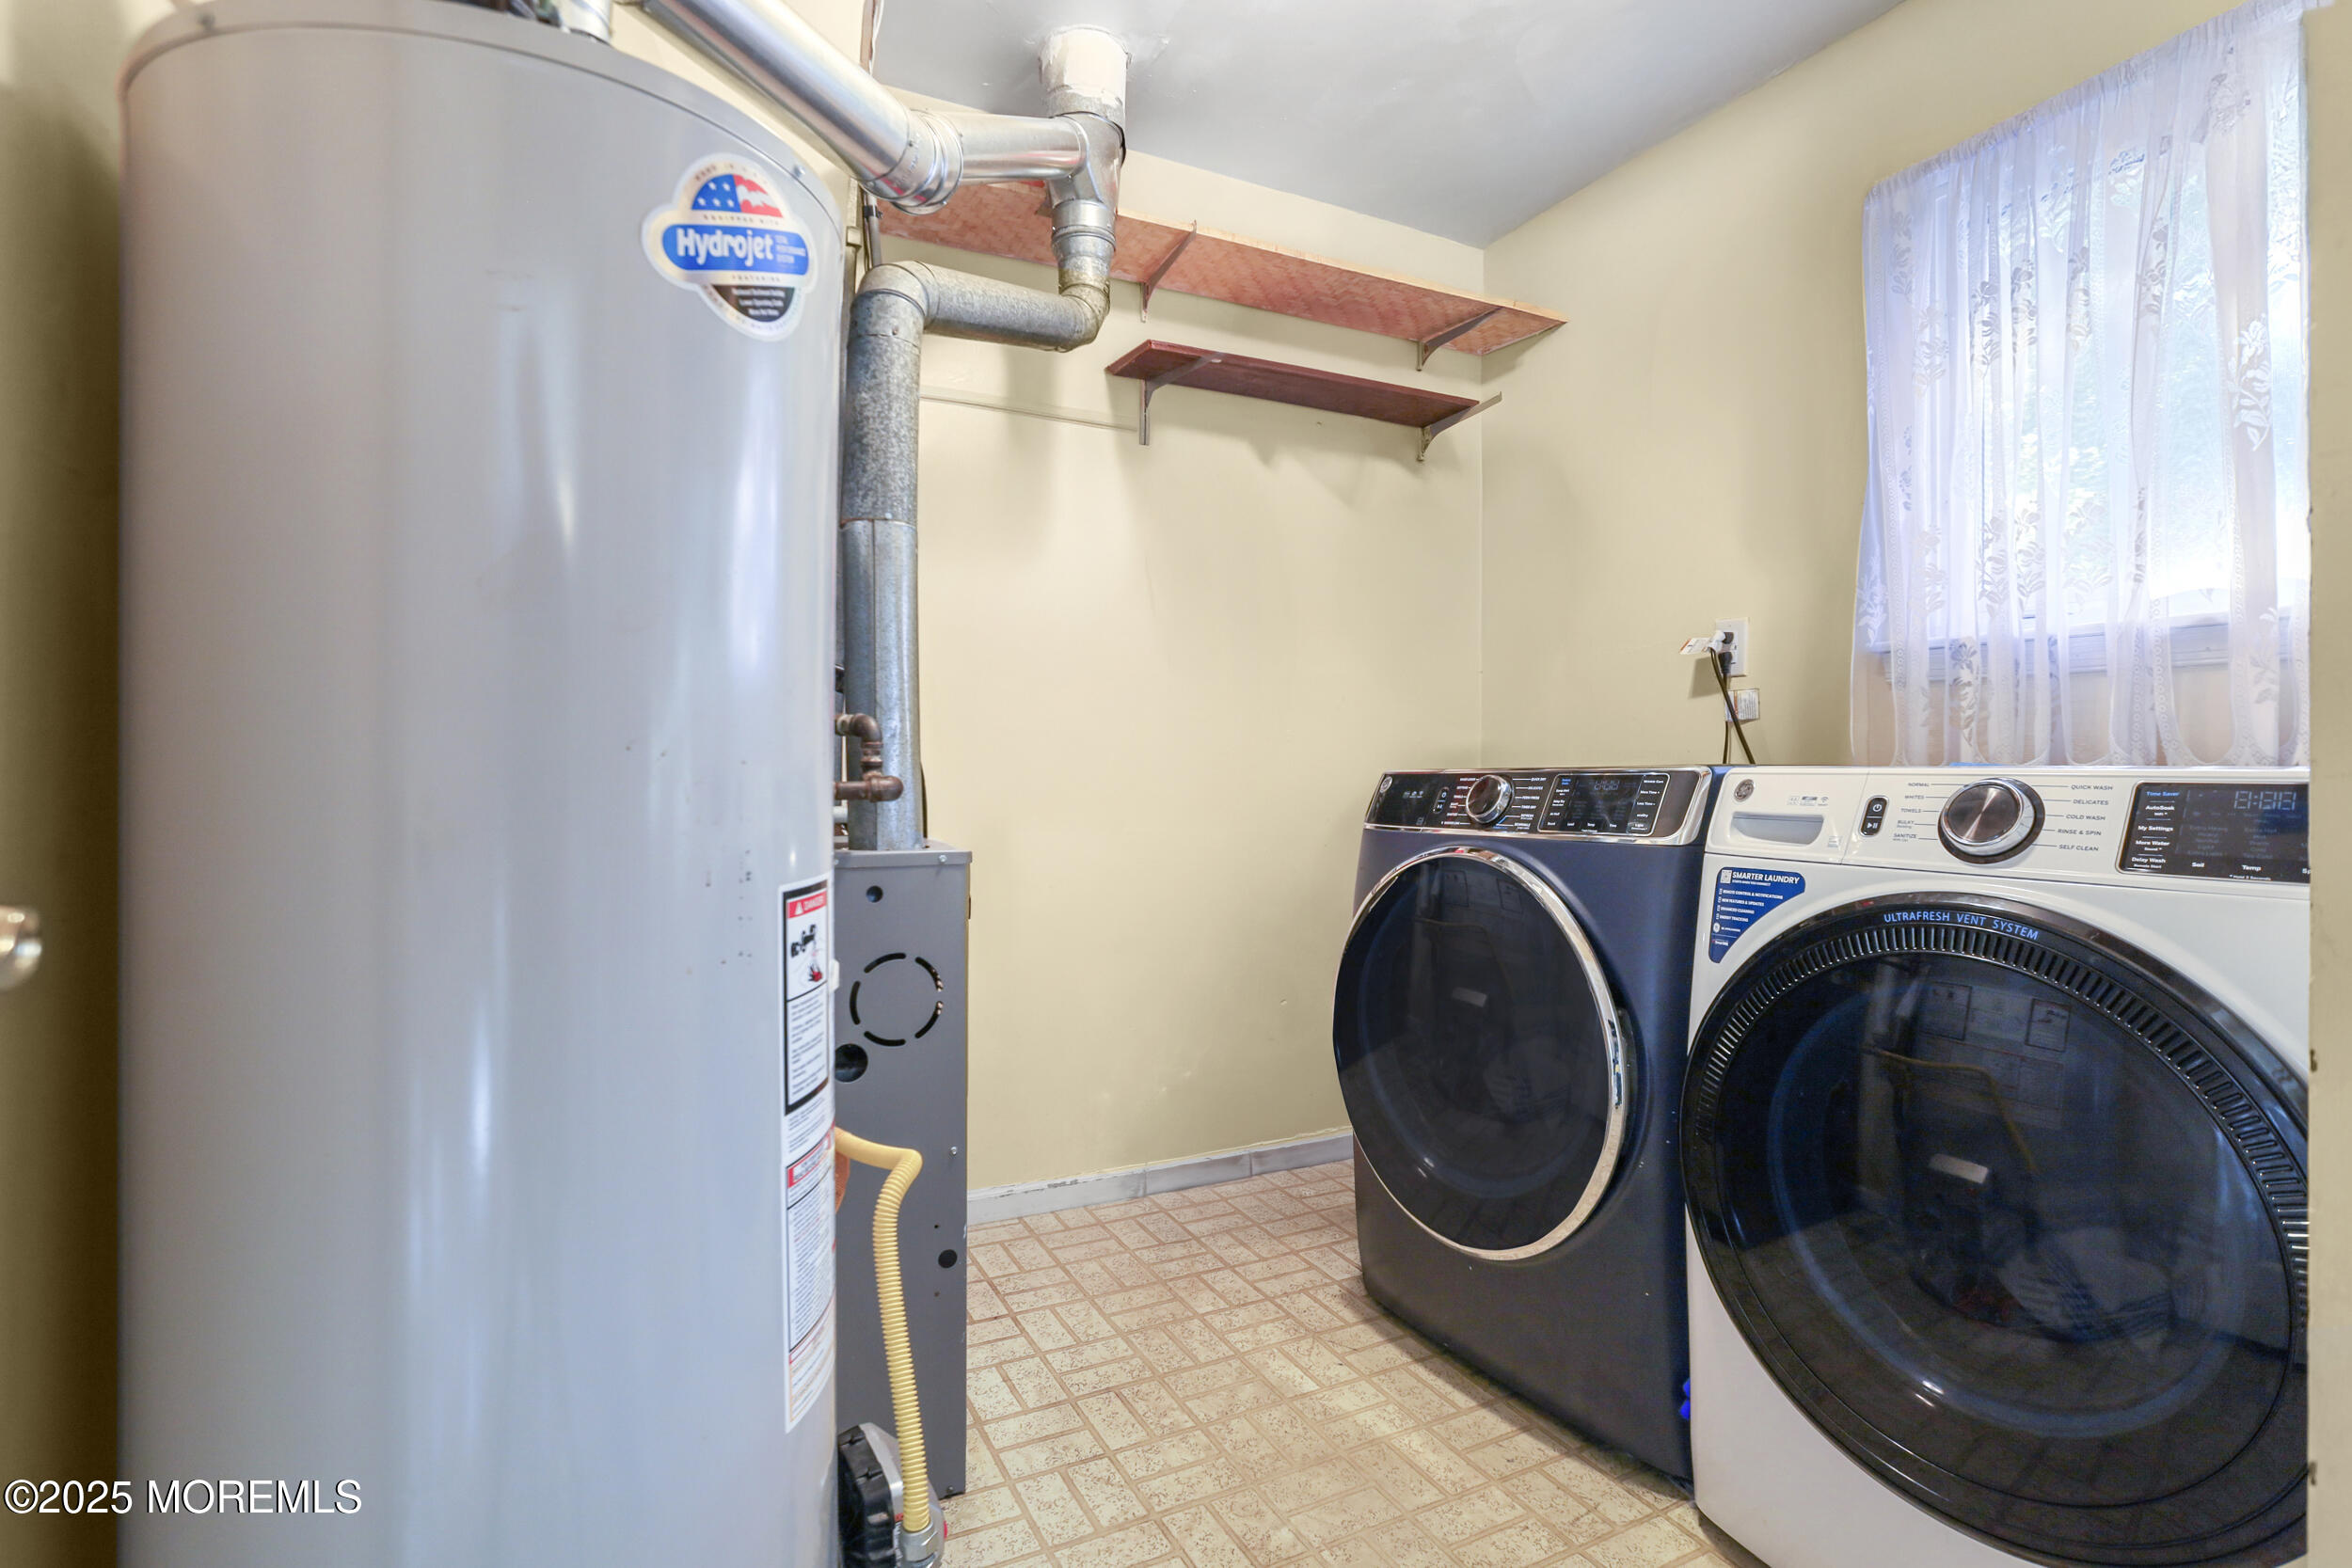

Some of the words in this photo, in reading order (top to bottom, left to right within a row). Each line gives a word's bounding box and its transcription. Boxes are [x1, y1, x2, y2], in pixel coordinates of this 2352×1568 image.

[676, 228, 773, 267] Hydrojet
[1732, 871, 1763, 881] SMARTER
[1764, 874, 1801, 884] LAUNDRY
[1755, 892, 1784, 900] NOTIFICATIONS
[1883, 911, 1950, 923] ULTRAFRESH
[1956, 913, 1987, 927] VENT
[1992, 919, 2039, 941] SYSTEM
